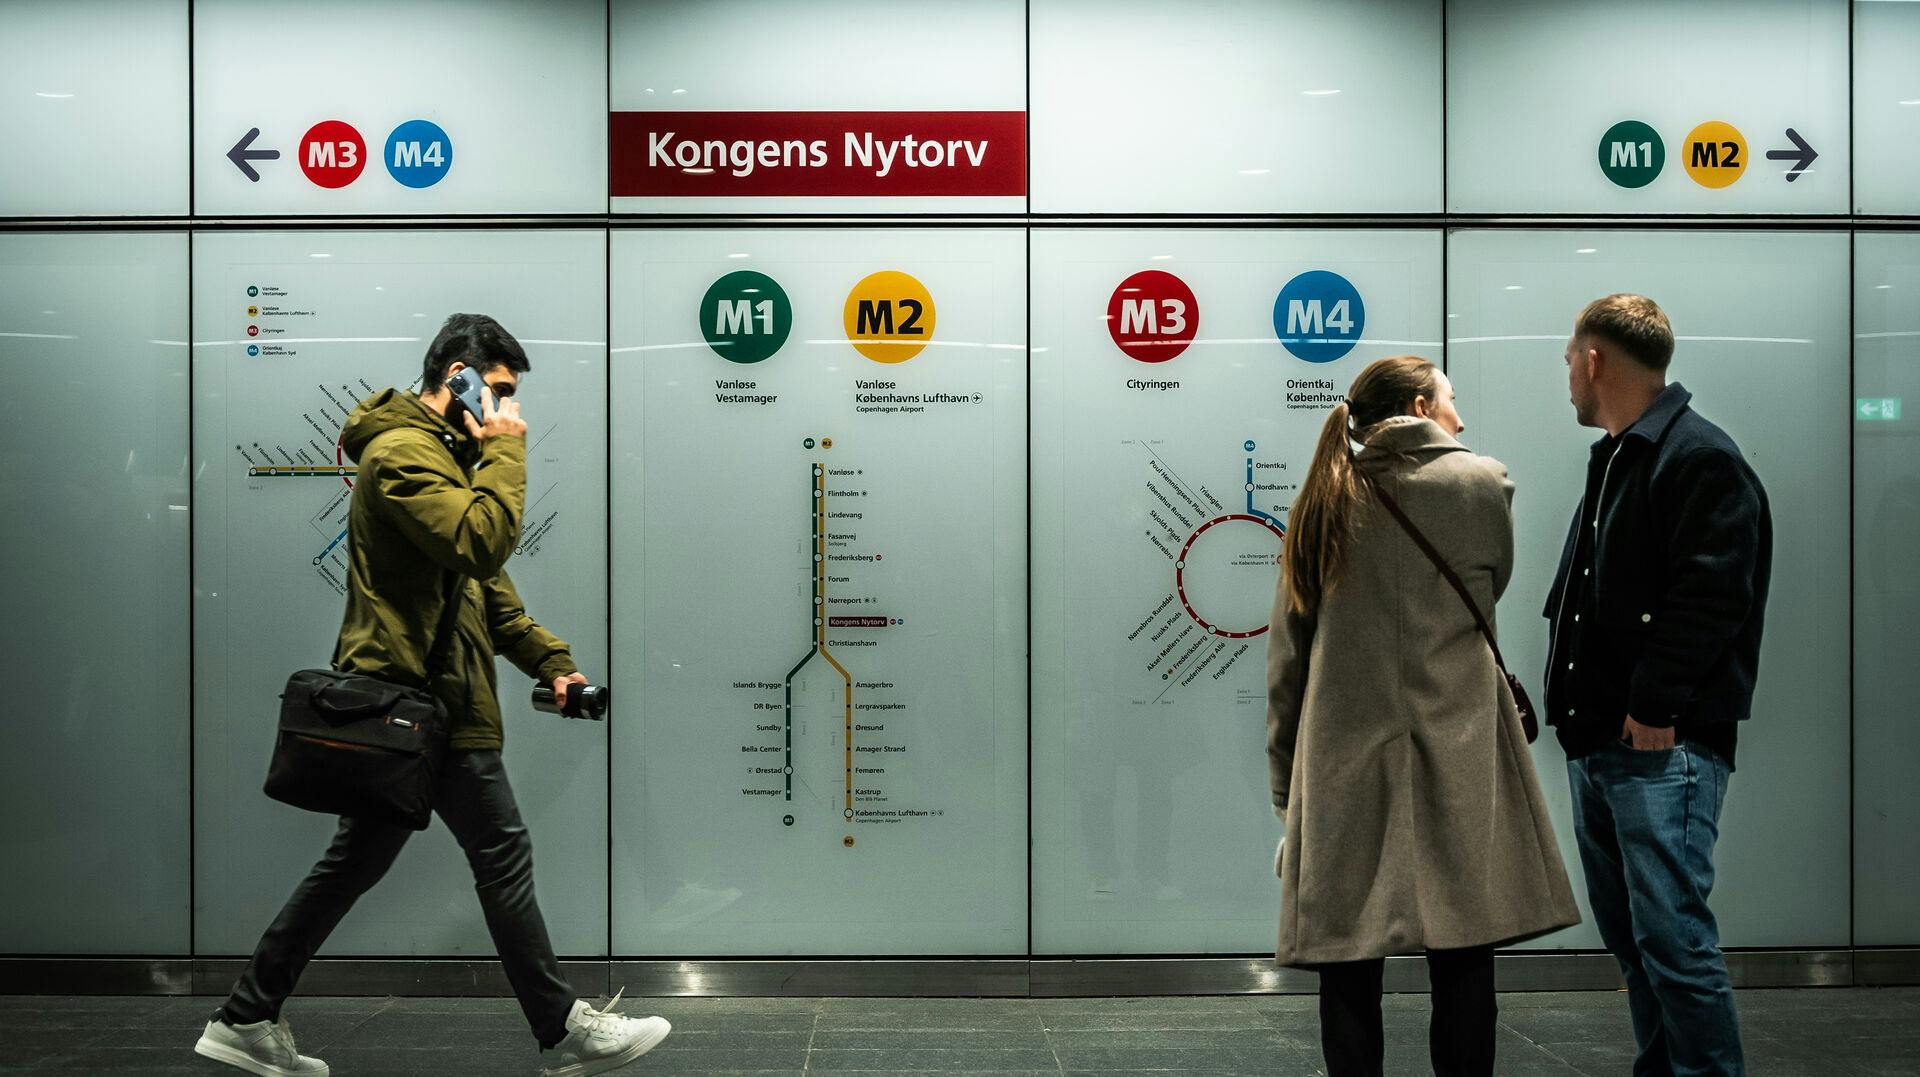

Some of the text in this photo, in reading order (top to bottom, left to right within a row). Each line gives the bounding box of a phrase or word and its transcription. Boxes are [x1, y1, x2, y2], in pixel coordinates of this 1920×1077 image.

[308, 141, 358, 168] M3
[394, 141, 445, 167] M4
[648, 131, 989, 177] Kongens Nytorv
[1610, 141, 1652, 168] M1
[1691, 141, 1740, 168] M2
[715, 299, 774, 335] M1
[856, 298, 924, 335] M2
[1120, 298, 1187, 335] M3
[1286, 299, 1355, 335] M4
[715, 379, 757, 390] Vanløse
[855, 379, 896, 390] Vanløse
[1126, 379, 1180, 391] Cityringen
[1286, 379, 1334, 391] Orientkaj
[715, 393, 778, 406] Vestamager
[855, 393, 969, 404] Københavns Lufthavn
[1286, 392, 1345, 401] København
[900, 405, 924, 414] Airport
[1256, 462, 1287, 470] Orientkaj
[1149, 460, 1206, 518] Poul Henningsens Plads
[1200, 485, 1223, 511] Trianglen
[1146, 481, 1193, 529] Vibenshus Runddel
[828, 511, 862, 519] Lindevang
[1149, 510, 1181, 543] Skjolds Plads
[1150, 535, 1174, 560] Nørrebro
[828, 554, 874, 562] Frederiksberg
[828, 597, 862, 605] Nørreport
[830, 618, 860, 626] Kongens
[861, 618, 885, 626] Nytorv
[1128, 593, 1174, 641] Nørrebros Runddel
[1151, 611, 1182, 643] Nuuks Plads
[1147, 656, 1162, 672] Aksel
[1160, 638, 1180, 658] Møllers
[1179, 624, 1193, 640] Have
[1173, 635, 1208, 670] Frederiksberg
[1212, 643, 1249, 680] Enghave Plads
[1181, 652, 1216, 687] Frederiksberg
[758, 682, 782, 690] Brygge
[855, 682, 894, 690] Amagerbro
[765, 703, 782, 711] Byen
[855, 703, 906, 711] Lergravsparken
[756, 724, 782, 732] Sundby
[855, 746, 882, 754] Amager
[742, 788, 782, 797] Vestamager
[855, 788, 882, 796] Kastrup
